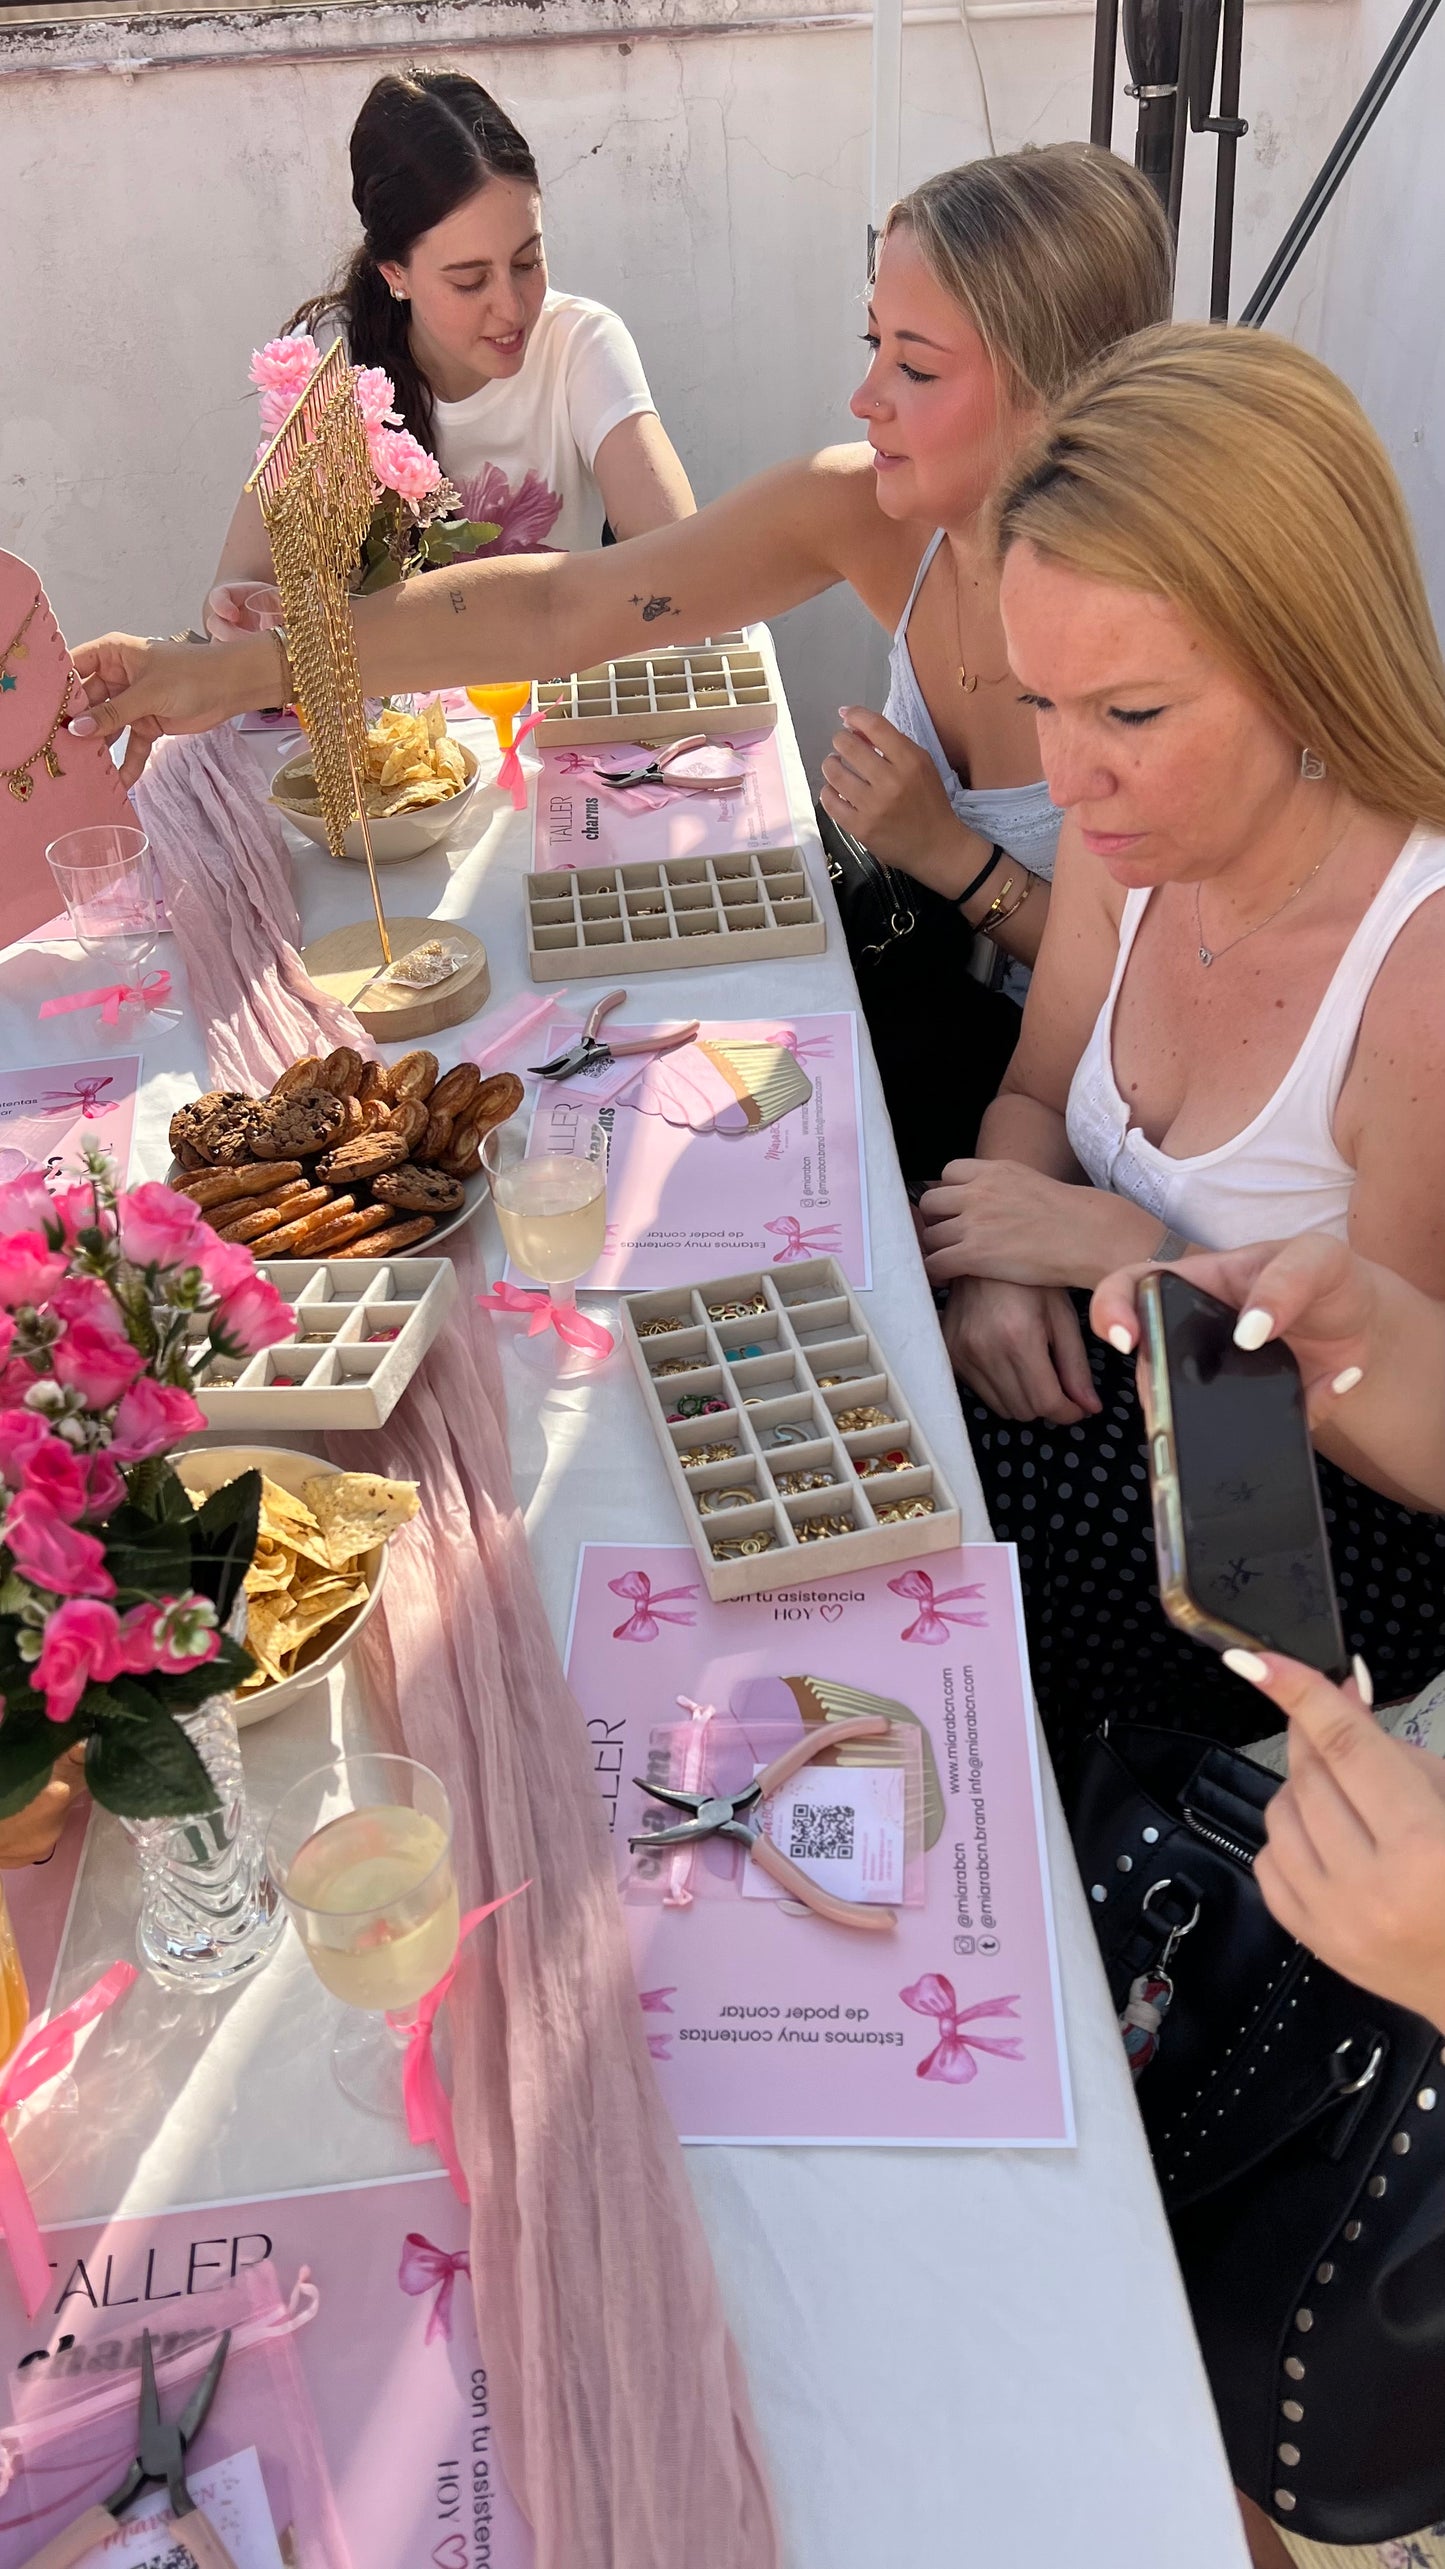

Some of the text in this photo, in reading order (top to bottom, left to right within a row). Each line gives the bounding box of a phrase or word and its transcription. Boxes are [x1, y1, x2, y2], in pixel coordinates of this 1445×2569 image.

[550, 796, 572, 846] TALLER
[581, 797, 599, 840] charms
[620, 1241, 766, 1249] Estamos muy contentas
[689, 1230, 725, 1238] poder
[756, 1592, 773, 1602] tu
[777, 1590, 865, 1602] asistencia
[774, 1607, 814, 1621] HOY
[942, 1667, 960, 1794] www.miarabcn.com
[963, 1665, 983, 1794] info@miarabcn.com
[953, 1842, 973, 1928] @miarabcn
[971, 1798, 996, 1929] @miarabcn.brand
[719, 2004, 869, 2022] de poder contar
[679, 2027, 904, 2046] Estamos muy contentas
[48, 2233, 273, 2314] ALLER
[471, 2369, 488, 2418] con
[472, 2425, 491, 2453] tu
[437, 2461, 460, 2523] HOY
